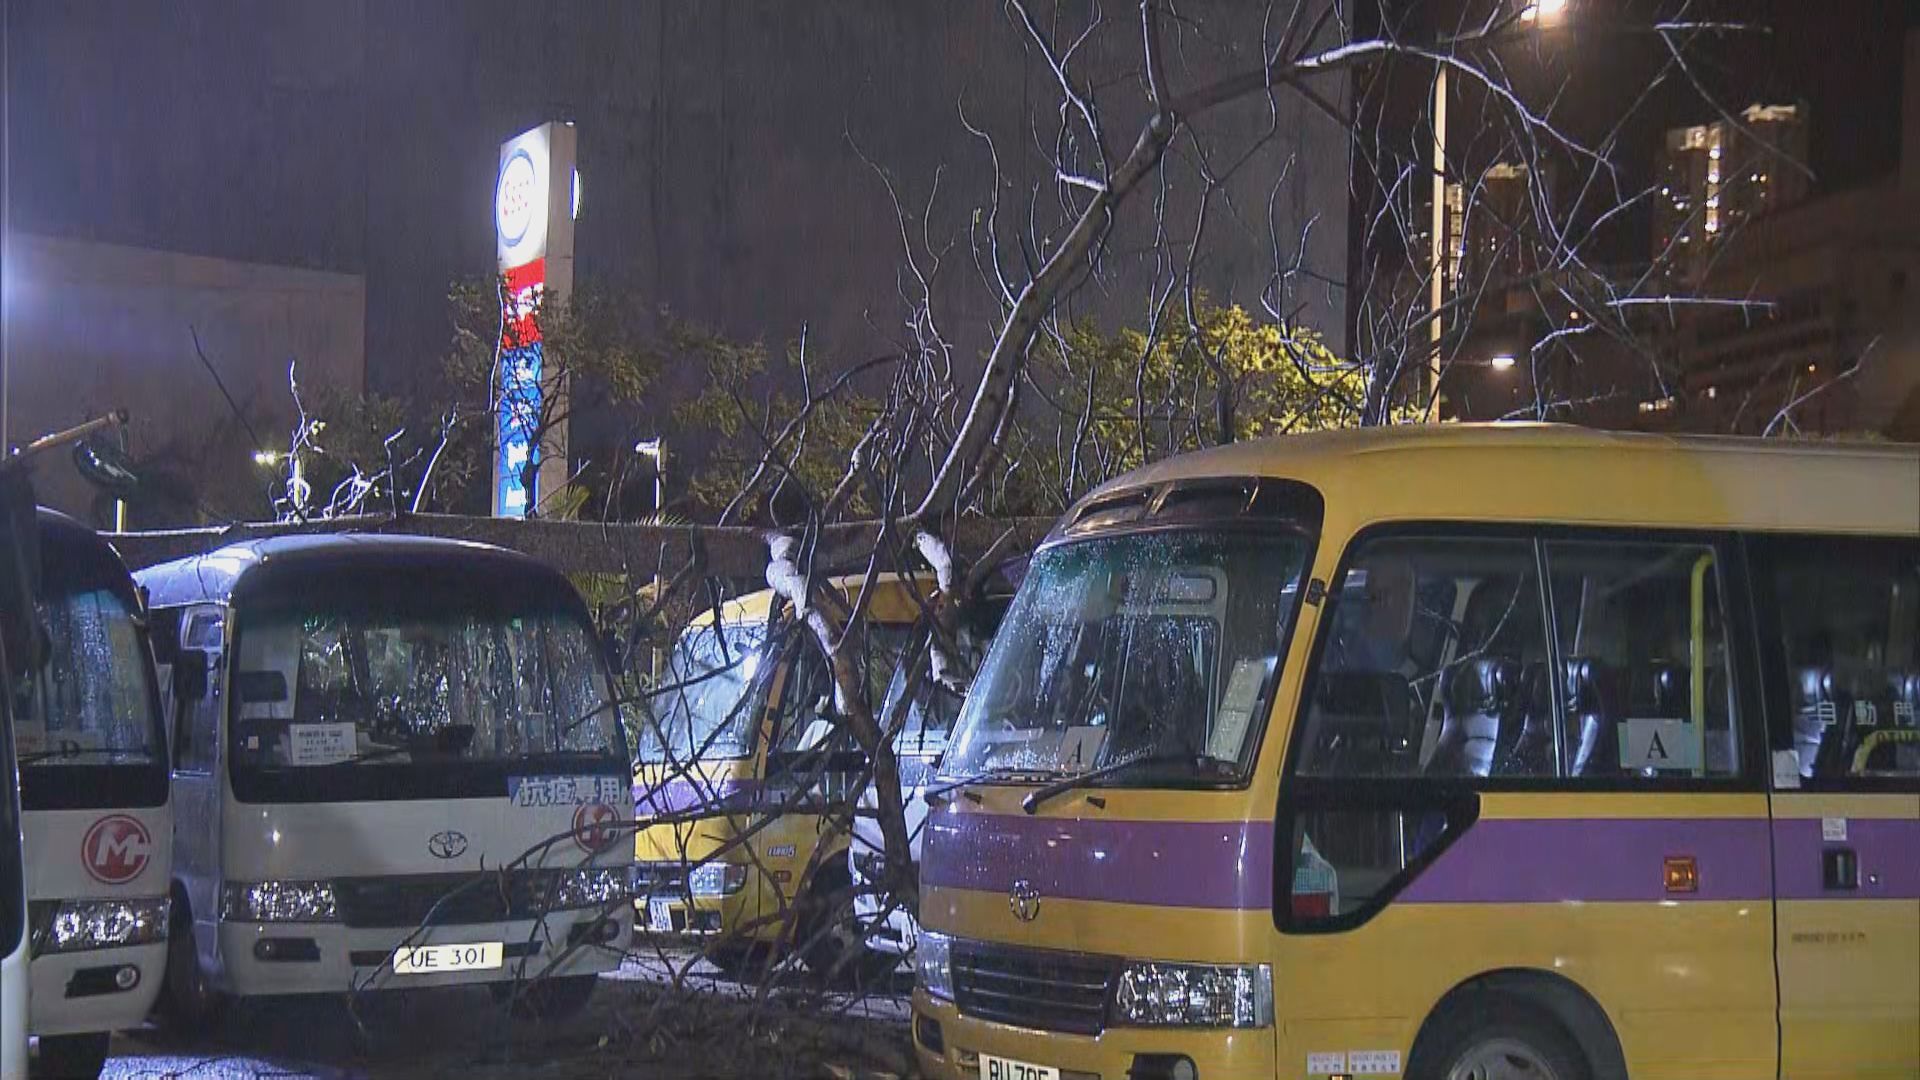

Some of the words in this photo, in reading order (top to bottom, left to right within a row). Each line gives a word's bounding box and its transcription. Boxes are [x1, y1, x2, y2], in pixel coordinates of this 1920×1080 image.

[1817, 700, 1916, 726] 自動門
[1647, 729, 1669, 759] A
[519, 776, 620, 807] 抗疫專用
[411, 950, 438, 967] UE
[450, 947, 484, 965] 301
